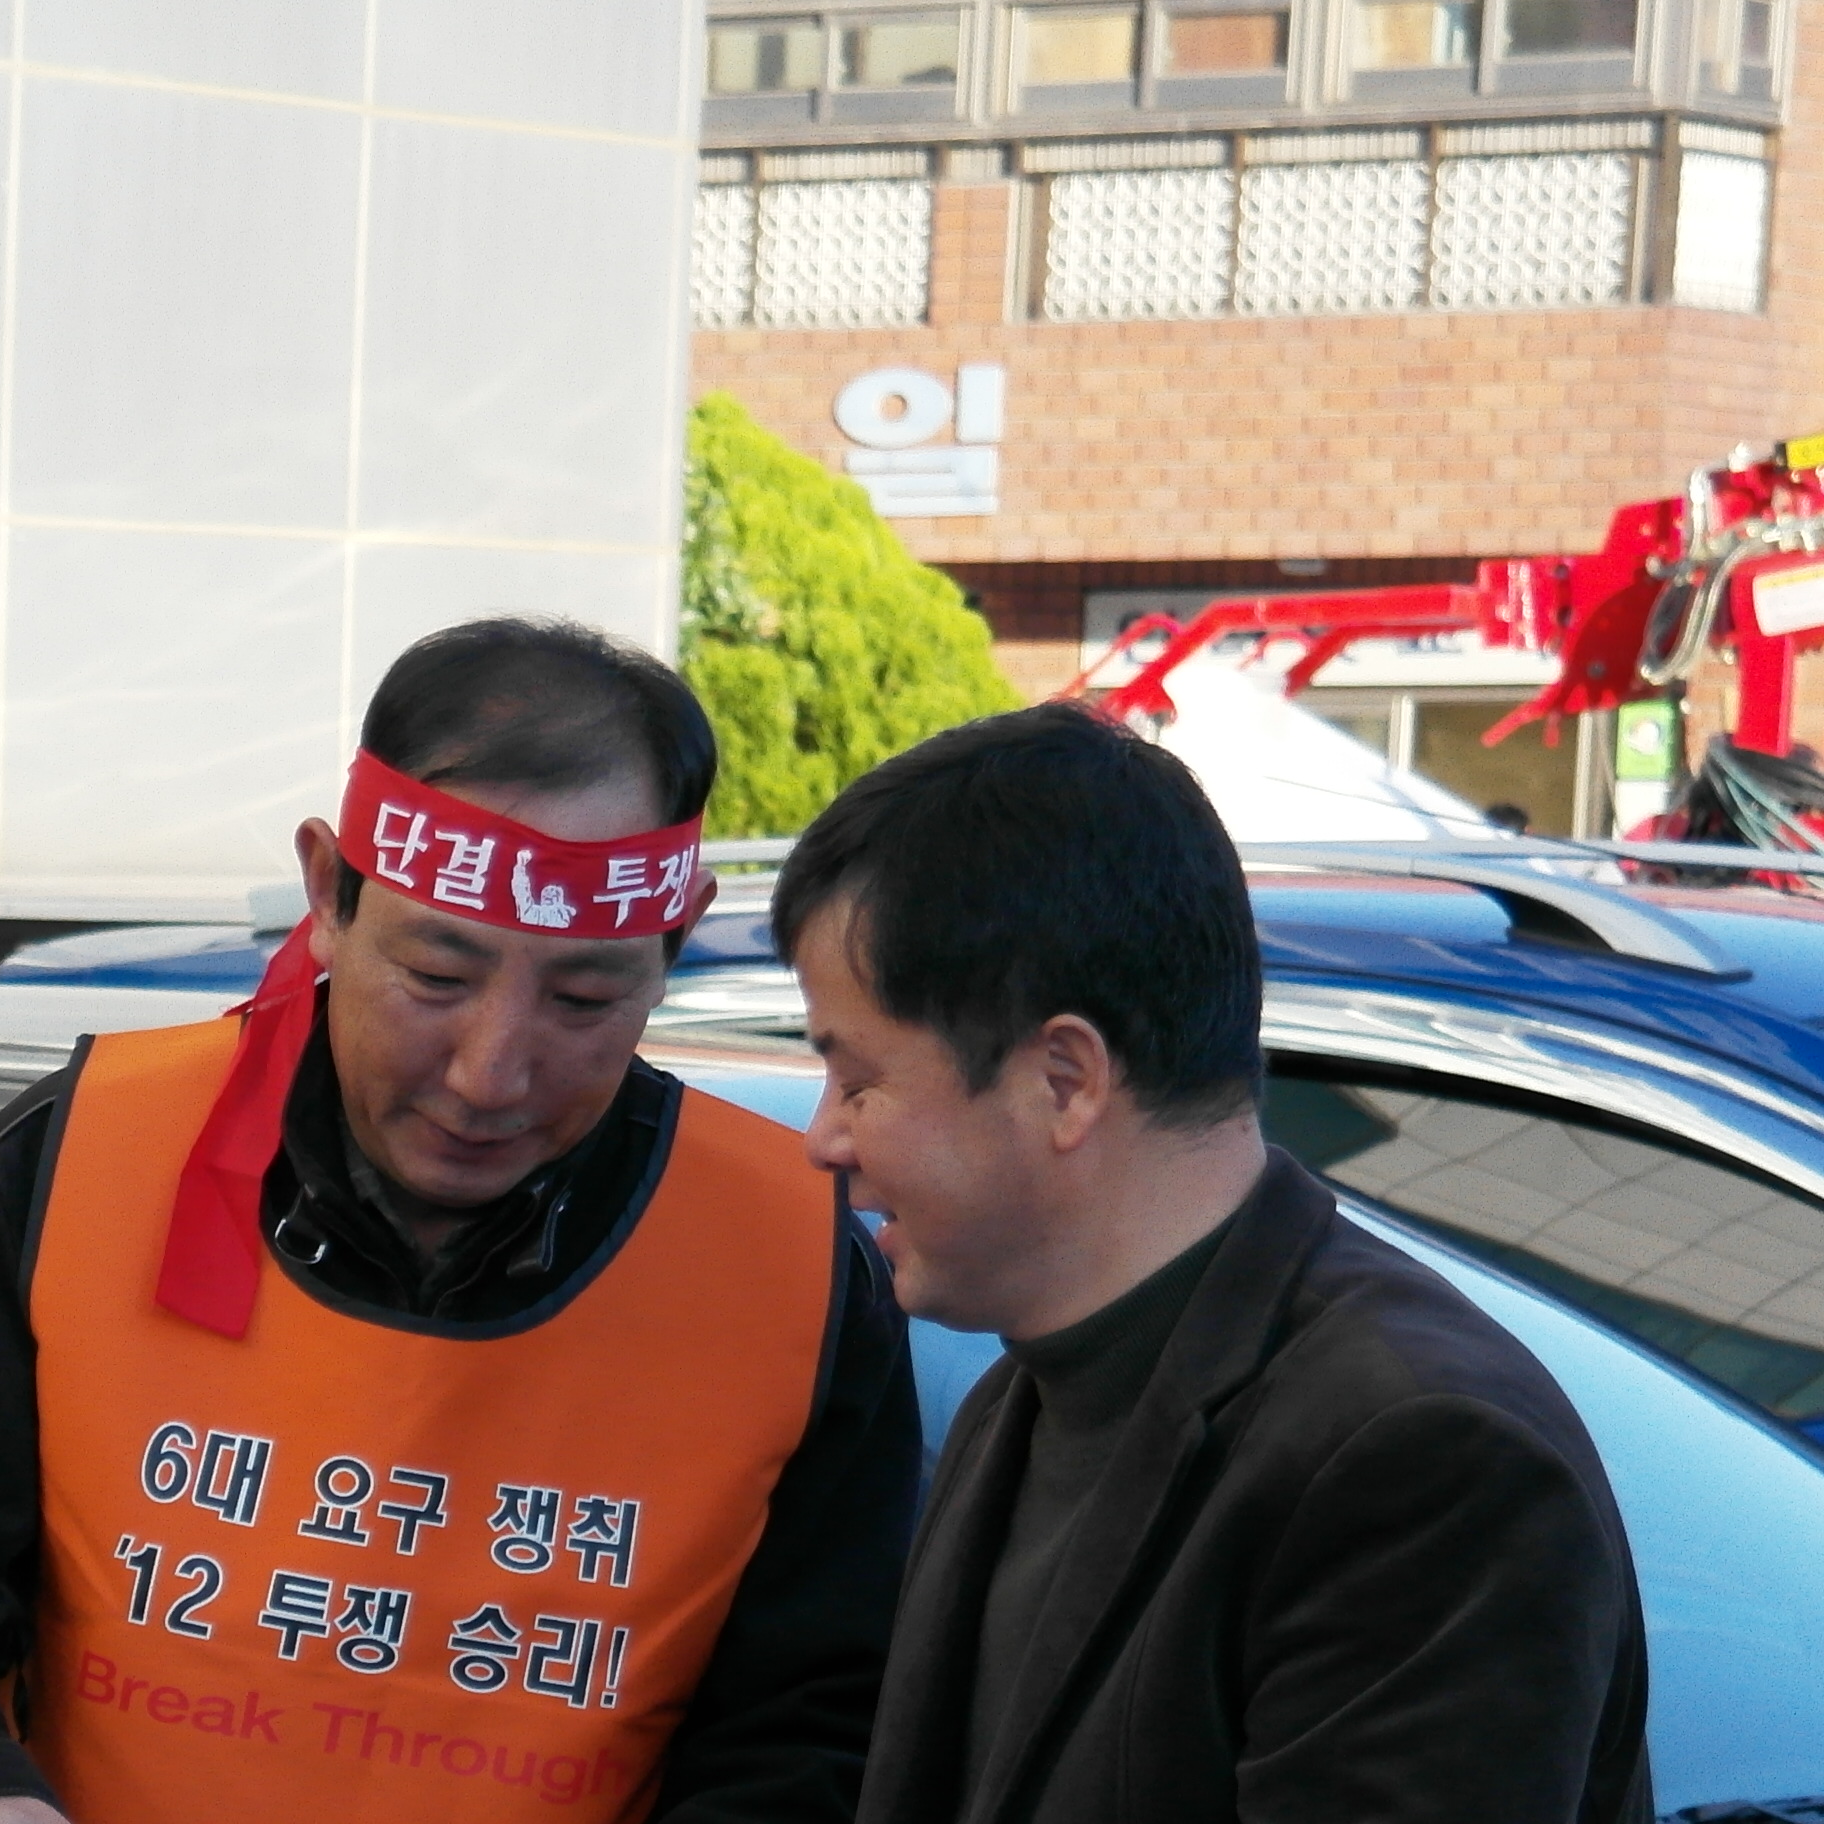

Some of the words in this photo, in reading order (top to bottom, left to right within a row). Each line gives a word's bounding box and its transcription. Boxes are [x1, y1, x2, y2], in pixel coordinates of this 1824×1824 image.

[372, 802, 496, 912] 단결
[592, 844, 695, 929] 투쟁
[141, 1420, 274, 1527] 6대
[298, 1455, 449, 1556] 요구
[488, 1483, 642, 1588] 쟁취
[114, 1534, 225, 1640] '12
[258, 1569, 412, 1675] 투쟁
[447, 1603, 630, 1710] 승리!
[77, 1649, 281, 1745] Break
[312, 1701, 632, 1803] Through
